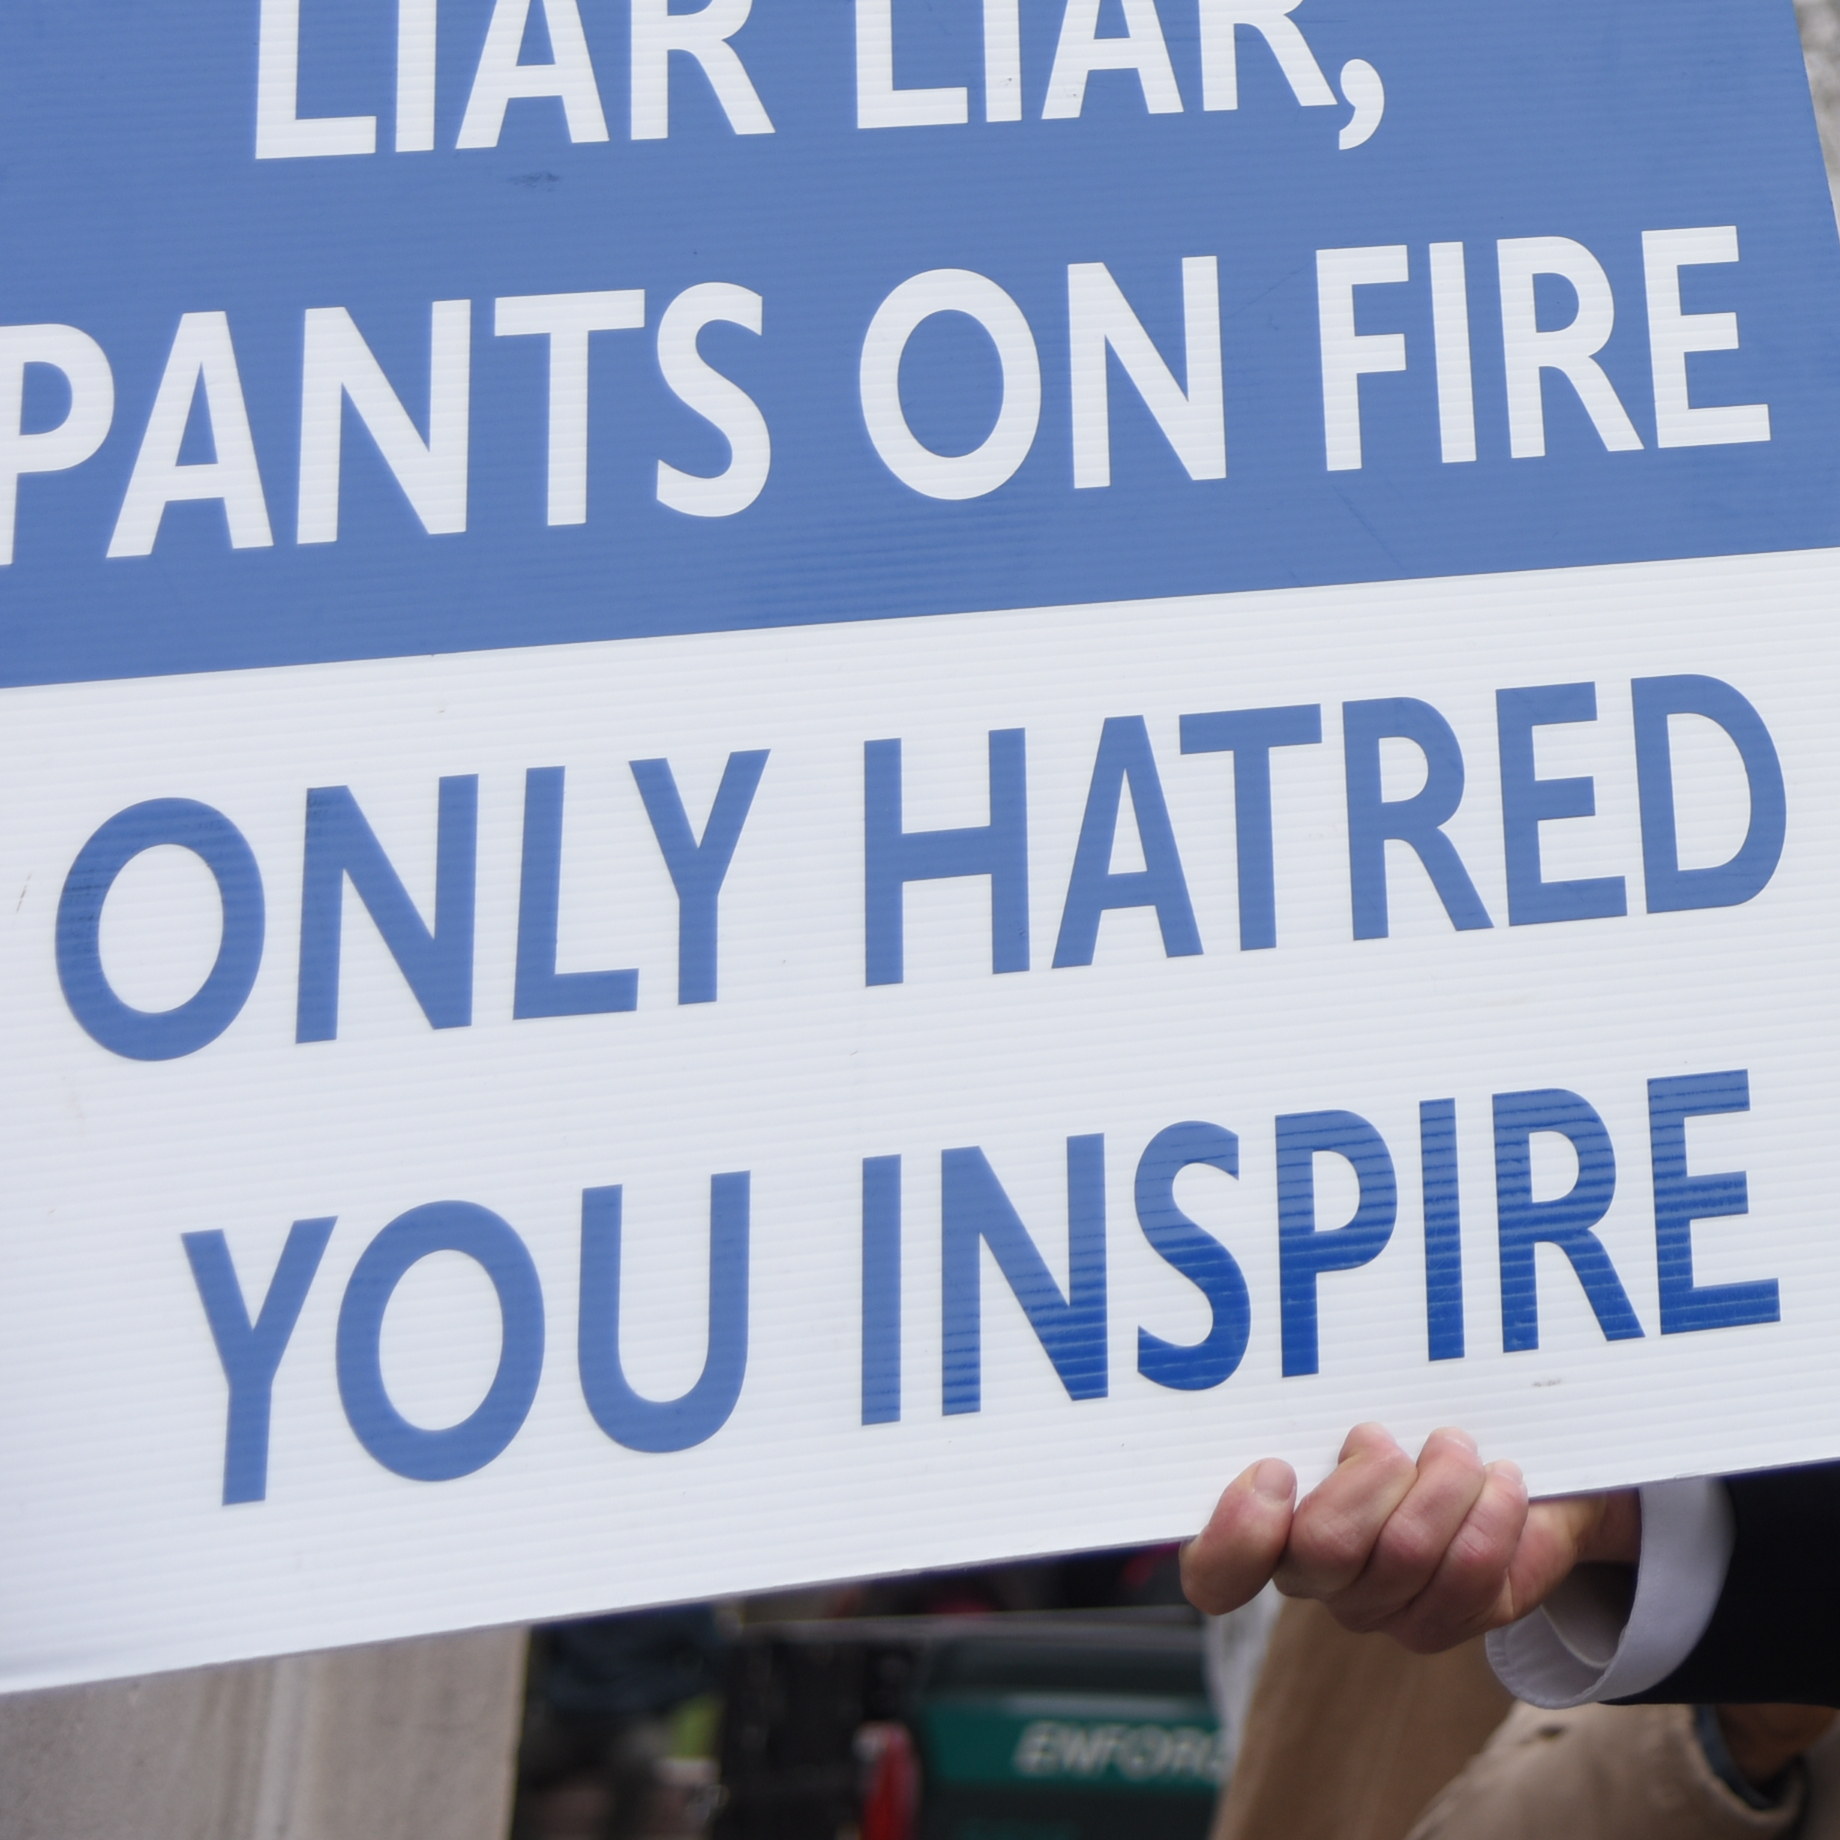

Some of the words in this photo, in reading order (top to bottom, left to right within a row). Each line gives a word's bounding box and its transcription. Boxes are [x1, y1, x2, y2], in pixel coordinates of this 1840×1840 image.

[0, 282, 772, 566] PANTS
[860, 255, 1228, 500] ON
[1316, 225, 1772, 471] FIRE
[57, 750, 769, 1060] ONLY
[866, 675, 1786, 985] HATRED
[184, 1172, 750, 1504] YOU
[863, 1070, 1781, 1424] INSPIRE
